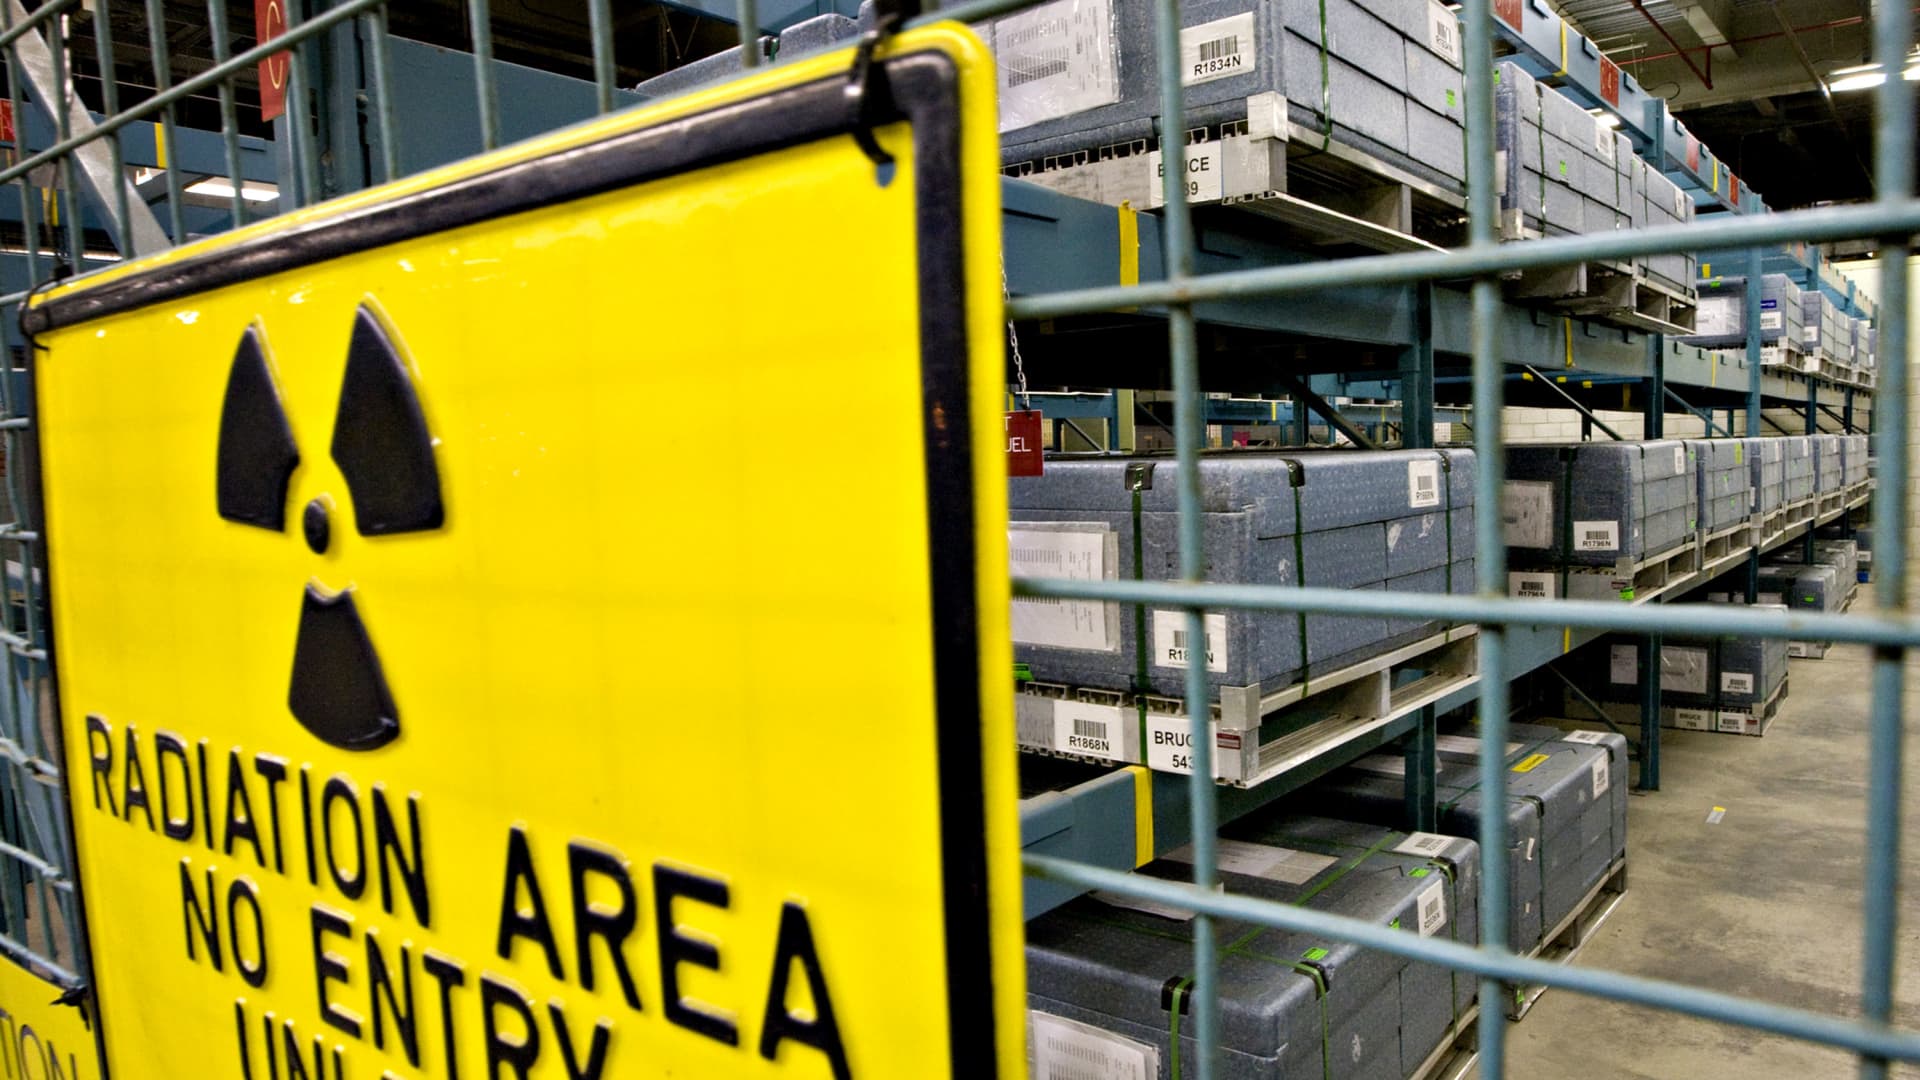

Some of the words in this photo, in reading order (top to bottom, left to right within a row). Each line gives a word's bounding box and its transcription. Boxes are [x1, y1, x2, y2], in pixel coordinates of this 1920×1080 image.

[1194, 54, 1241, 76] R1834N
[1168, 648, 1214, 664] R18N
[1069, 735, 1110, 752] R1868N
[1154, 730, 1194, 748] BRUC
[85, 714, 430, 930] RADIATION
[496, 820, 853, 1080] AREA
[180, 857, 267, 988] NO
[310, 902, 613, 1080] ENTRY
